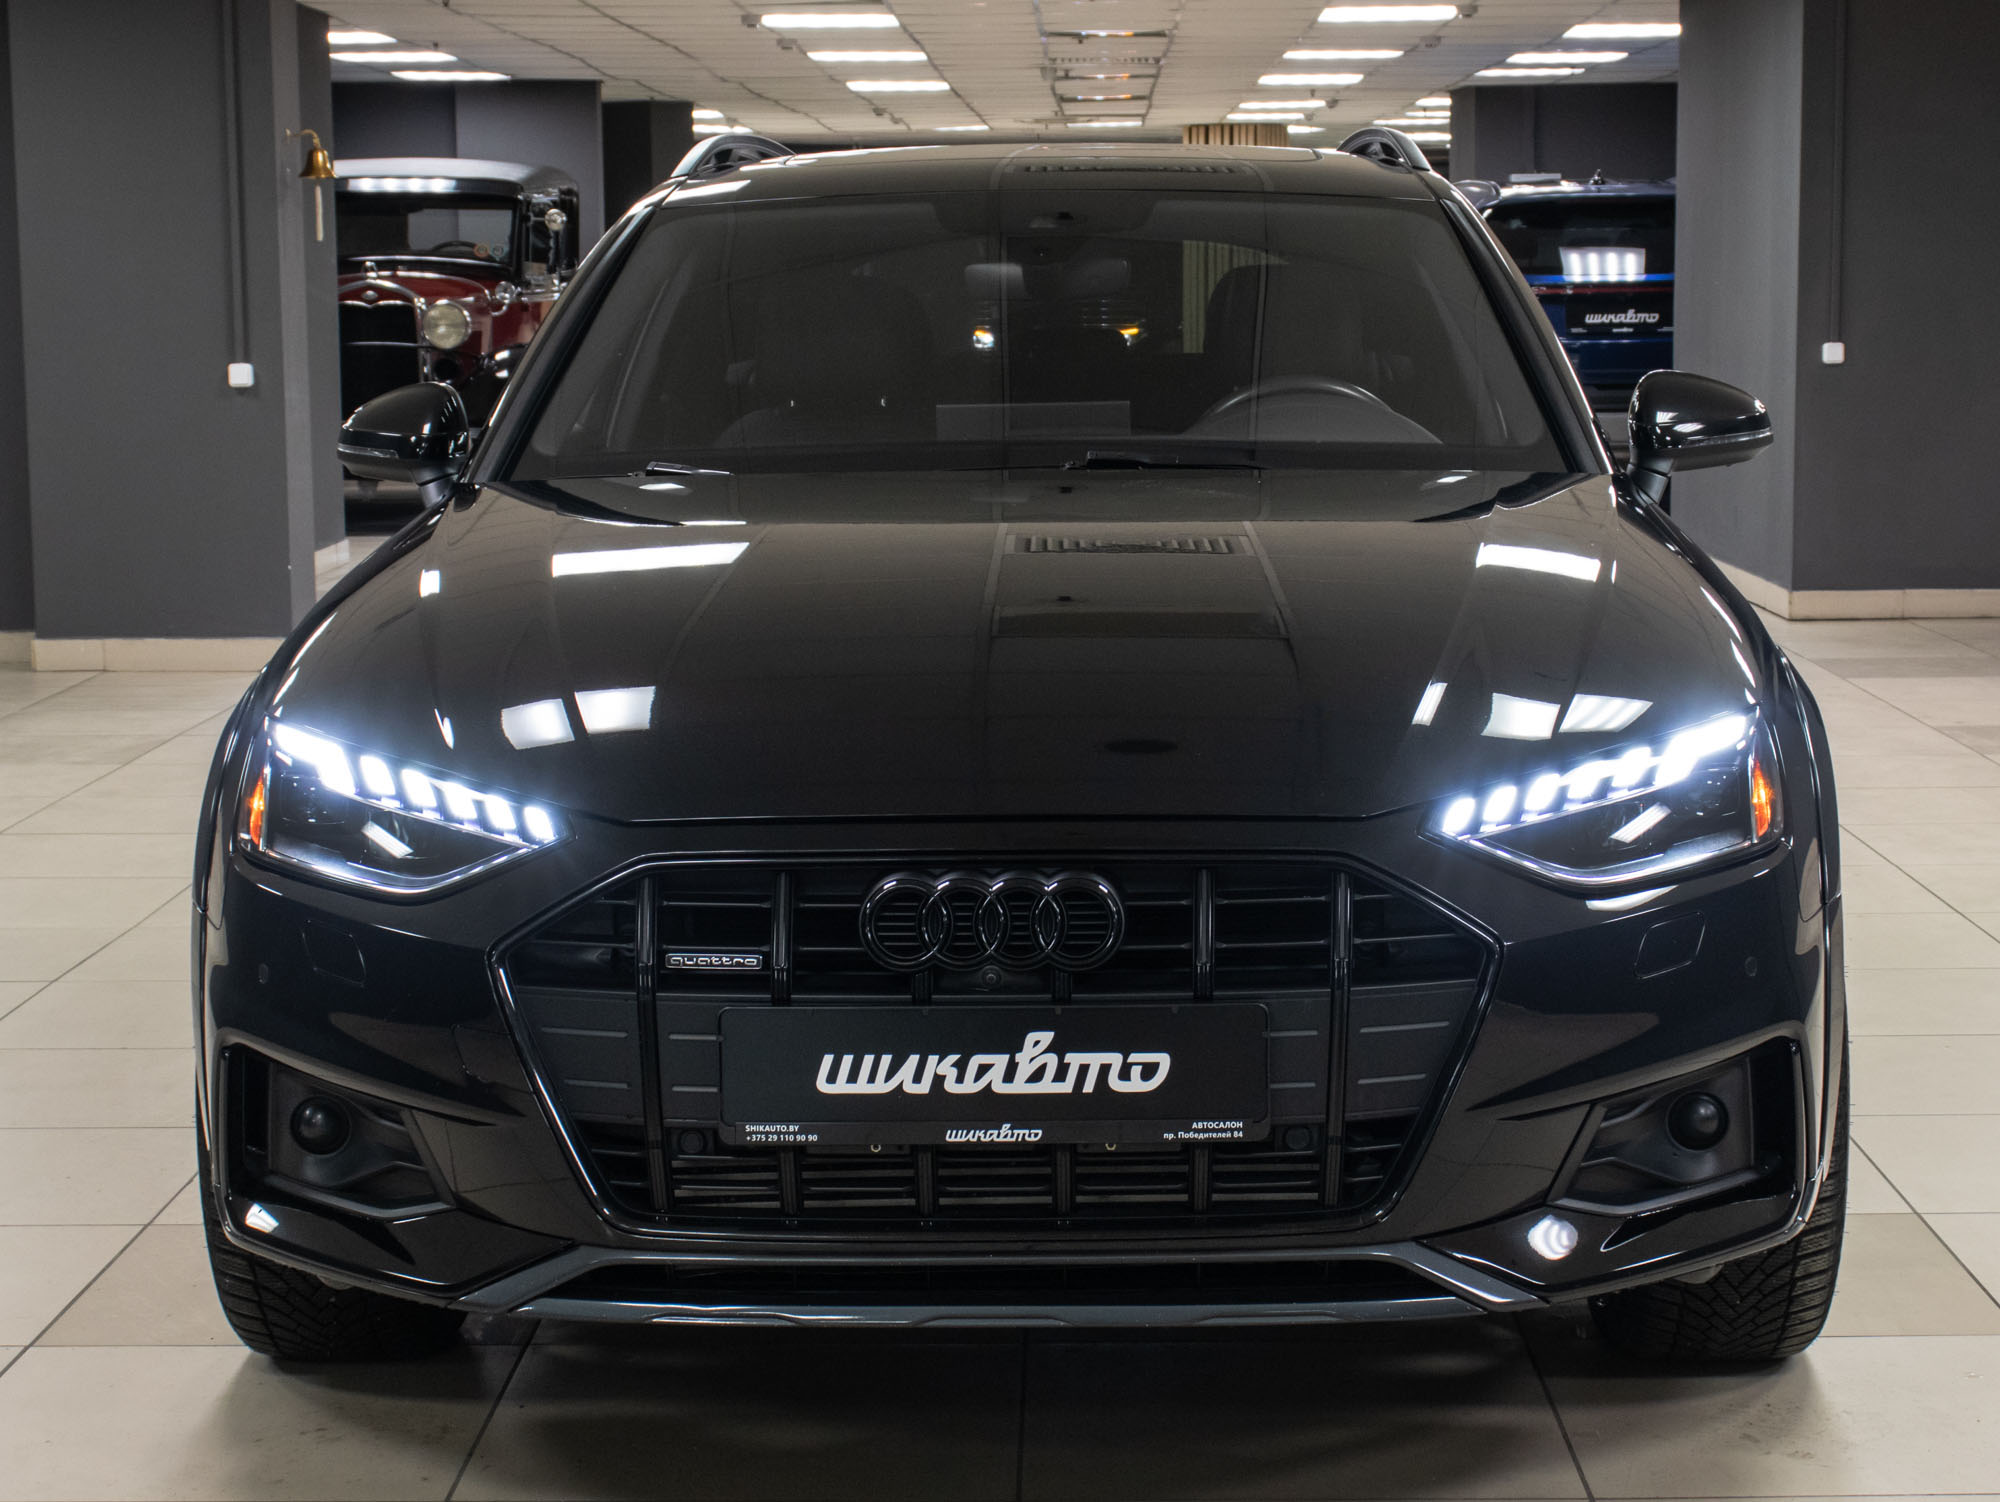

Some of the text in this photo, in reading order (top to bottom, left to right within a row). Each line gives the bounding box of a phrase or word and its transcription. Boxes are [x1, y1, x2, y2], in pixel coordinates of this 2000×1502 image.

[670, 956, 758, 967] quattro
[816, 1031, 1171, 1094] шикавто
[745, 1124, 800, 1132] SHIKAUTO.BY
[1191, 1121, 1243, 1129] АВТОСАЛОН
[945, 1123, 1043, 1142] шикавто
[1163, 1130, 1244, 1140] пр. Победителей 84
[746, 1134, 818, 1142] +375 29 110 90 90
